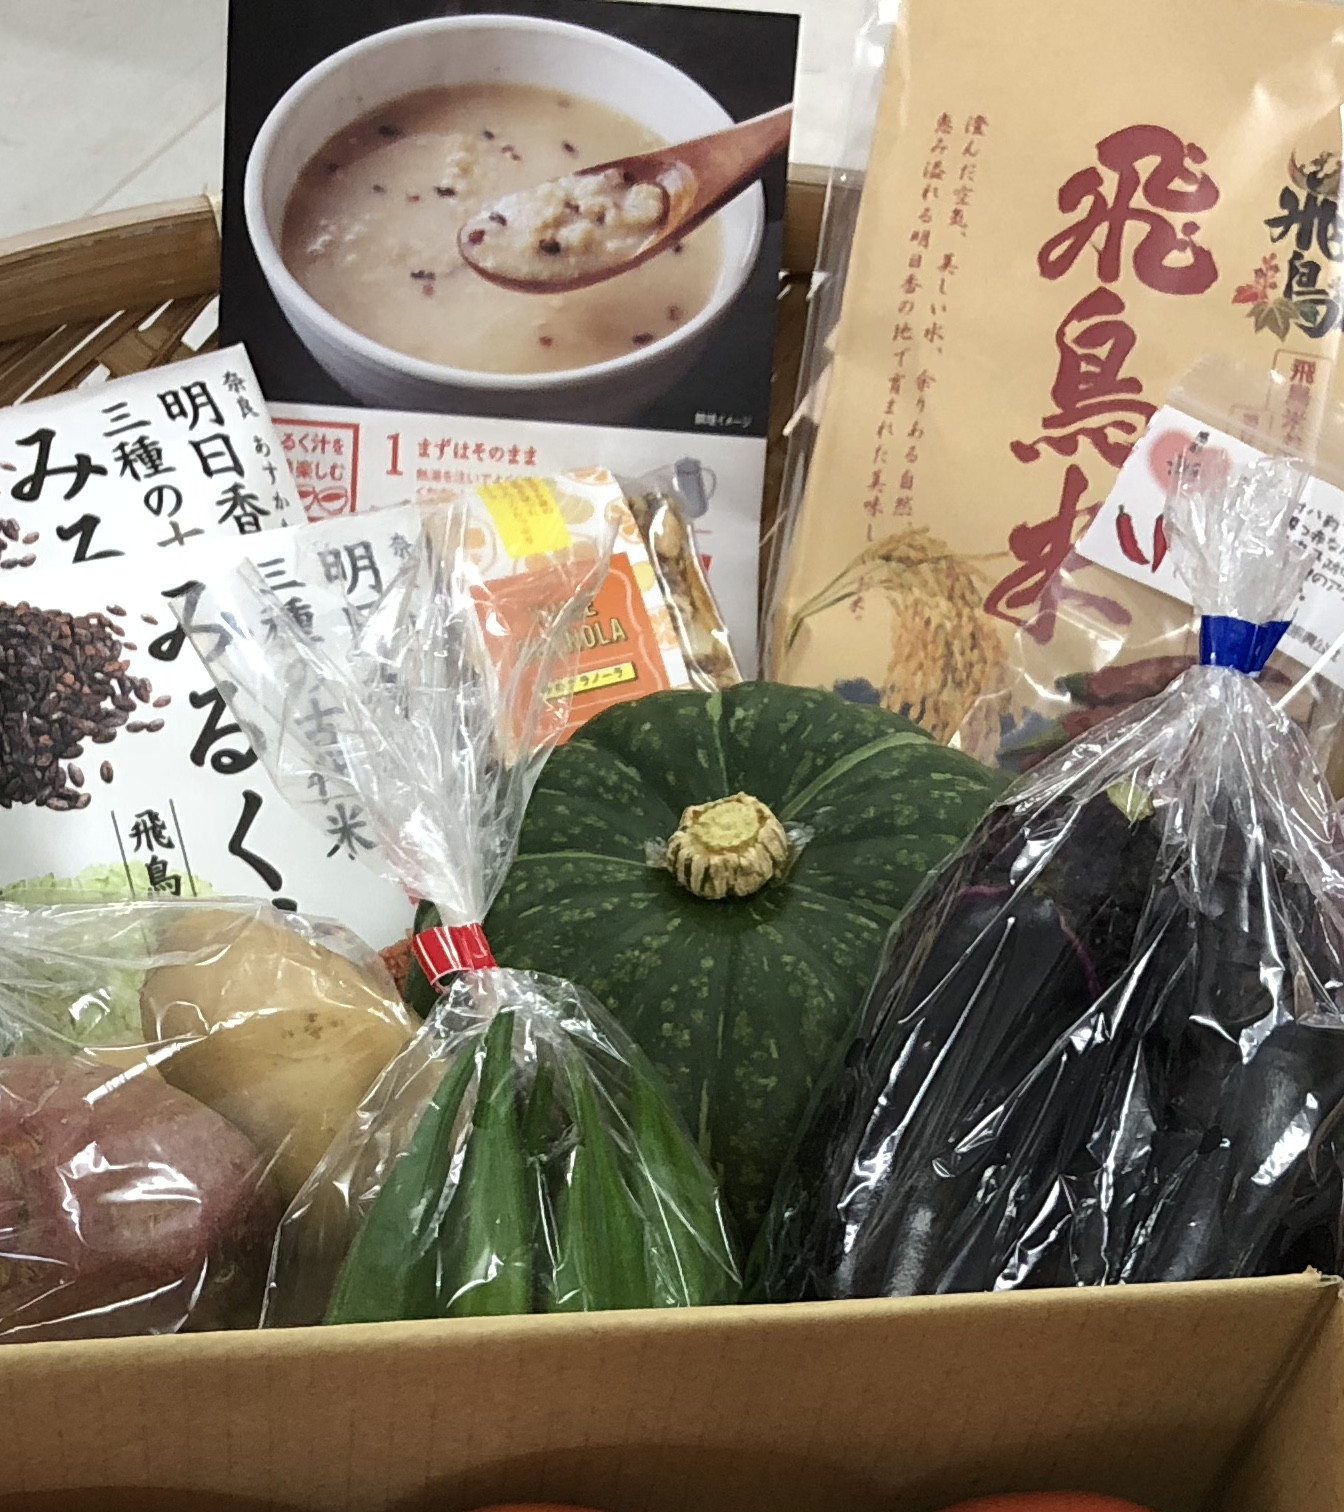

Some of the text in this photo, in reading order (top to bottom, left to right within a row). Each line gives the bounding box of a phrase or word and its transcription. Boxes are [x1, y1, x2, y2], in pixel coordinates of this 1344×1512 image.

[222, 370, 261, 420] 奈良
[288, 458, 346, 482] 楽しむ
[386, 432, 404, 477] 1
[417, 436, 538, 467] まずはそのまま
[129, 808, 182, 896] 飛鳥
